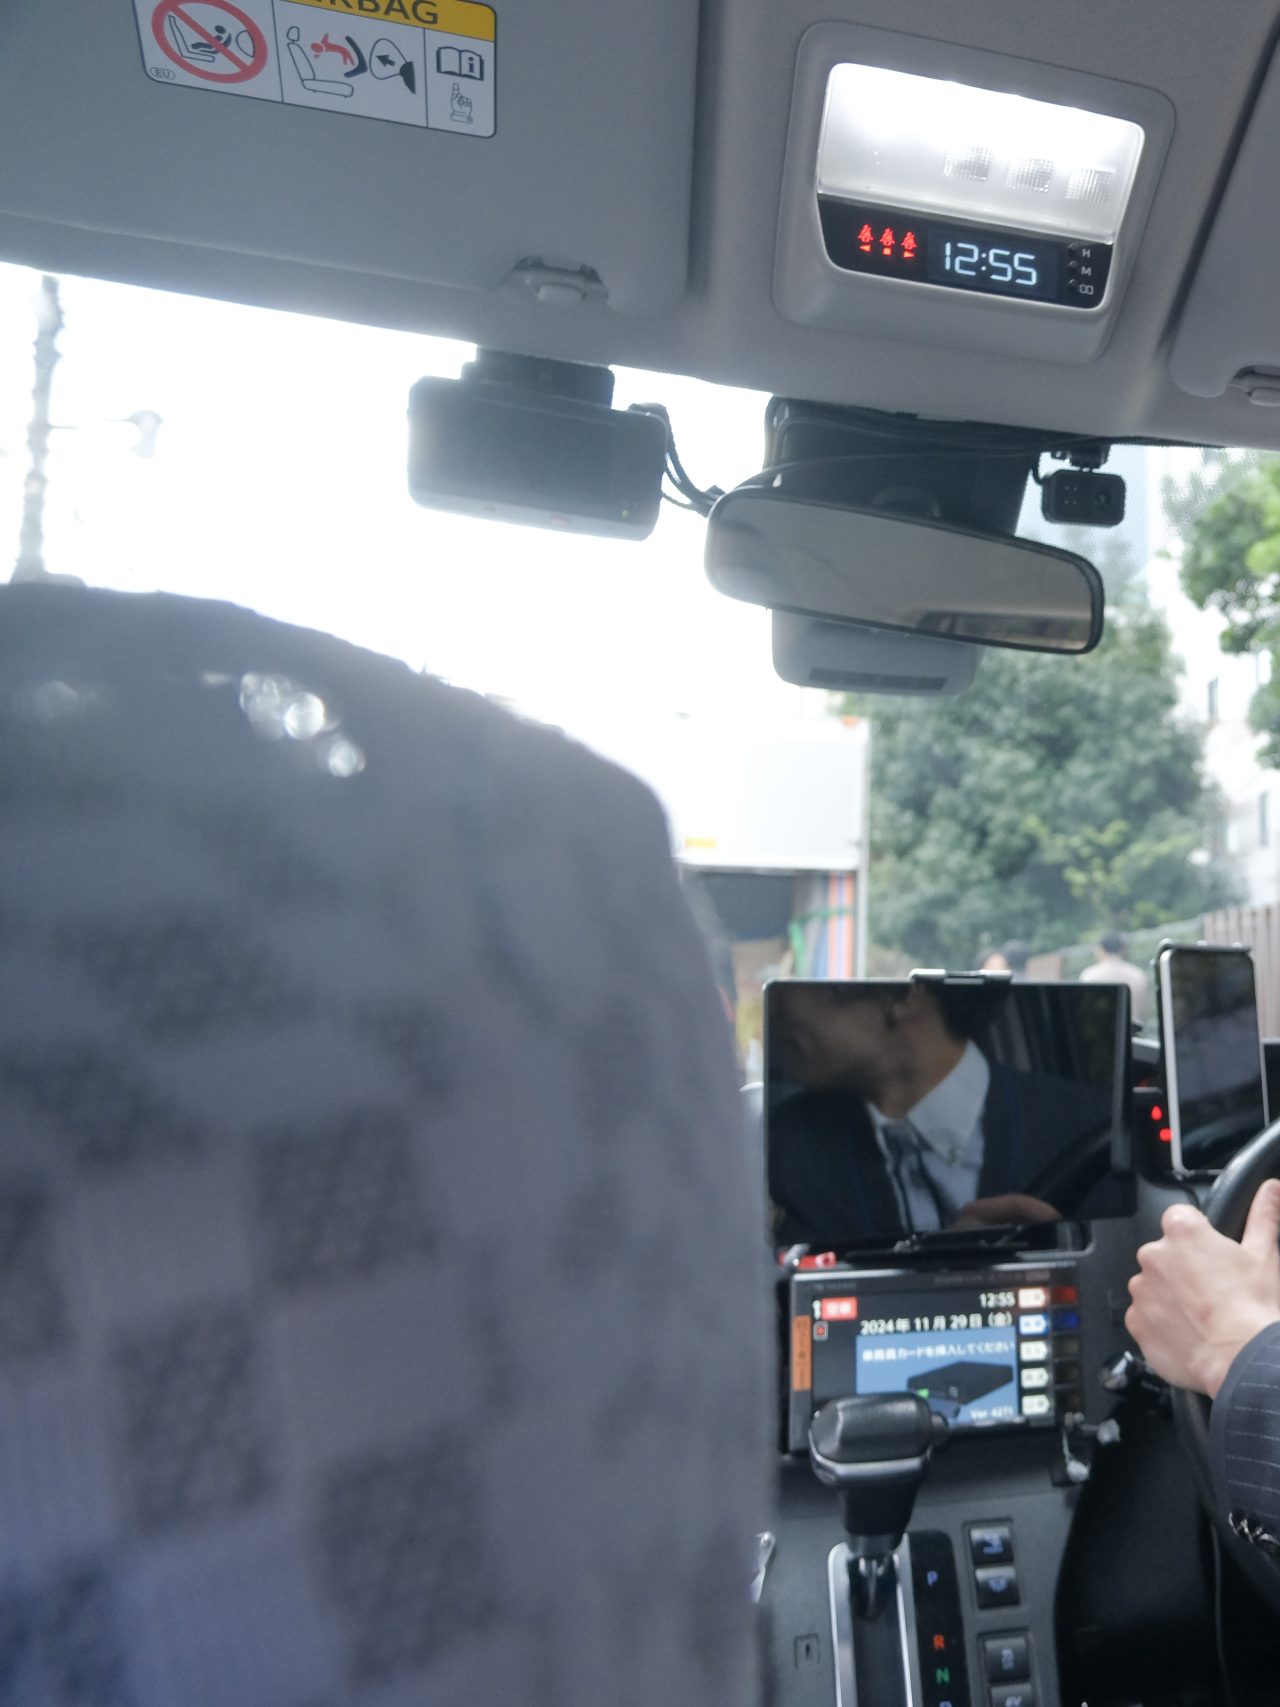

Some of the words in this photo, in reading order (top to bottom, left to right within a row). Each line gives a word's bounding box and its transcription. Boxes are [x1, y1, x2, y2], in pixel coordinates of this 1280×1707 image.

[1082, 248, 1091, 258] H
[945, 242, 1037, 286] 12:55
[1081, 266, 1092, 276] M
[980, 1291, 1016, 1308] 12:55
[927, 1570, 938, 1587] P
[934, 1634, 945, 1651] R
[936, 1668, 950, 1684] N
